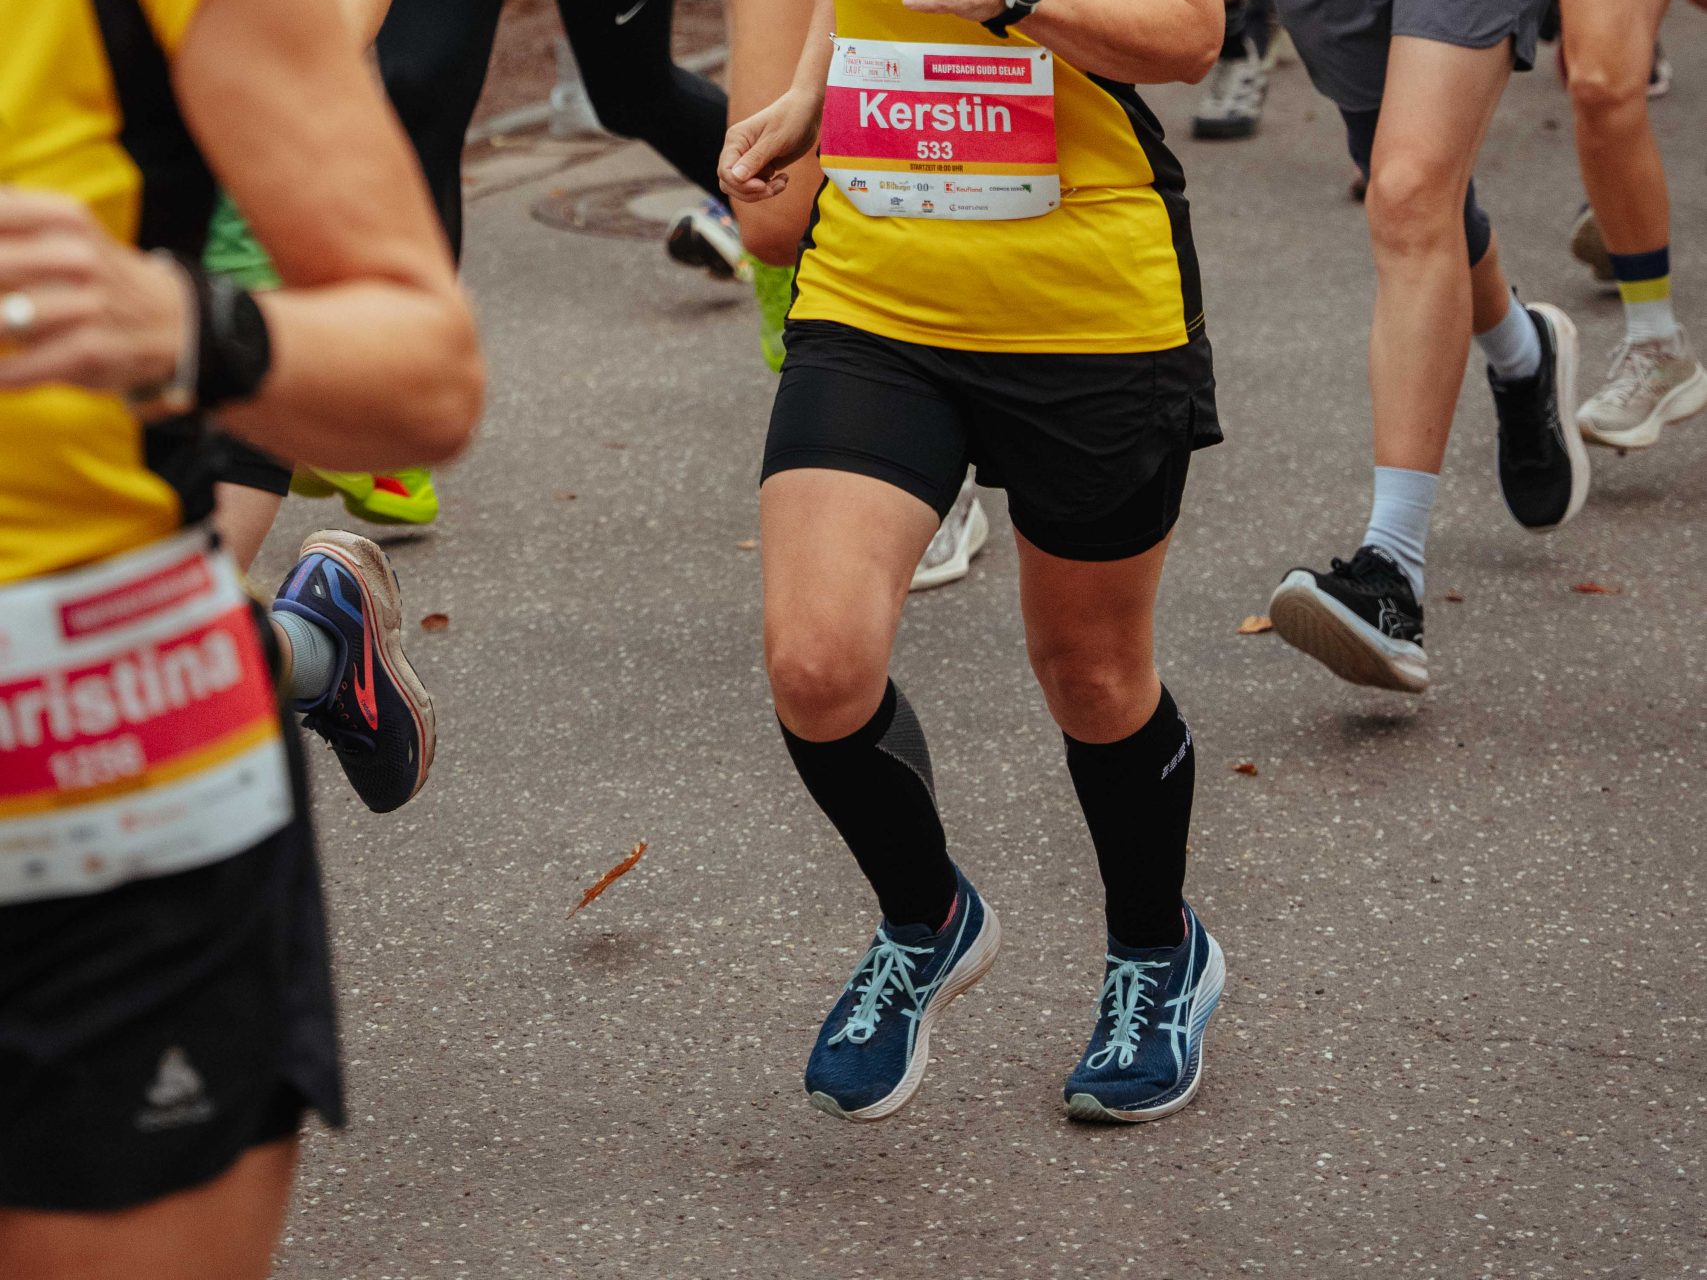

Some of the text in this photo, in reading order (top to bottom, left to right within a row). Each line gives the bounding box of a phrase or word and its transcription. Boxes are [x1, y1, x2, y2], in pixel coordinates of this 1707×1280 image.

[932, 64, 975, 74] HAUPTSACH
[998, 66, 1025, 76] GELAAF
[859, 92, 1012, 133] Kerstin
[917, 141, 953, 160] 533
[851, 177, 866, 187] dm
